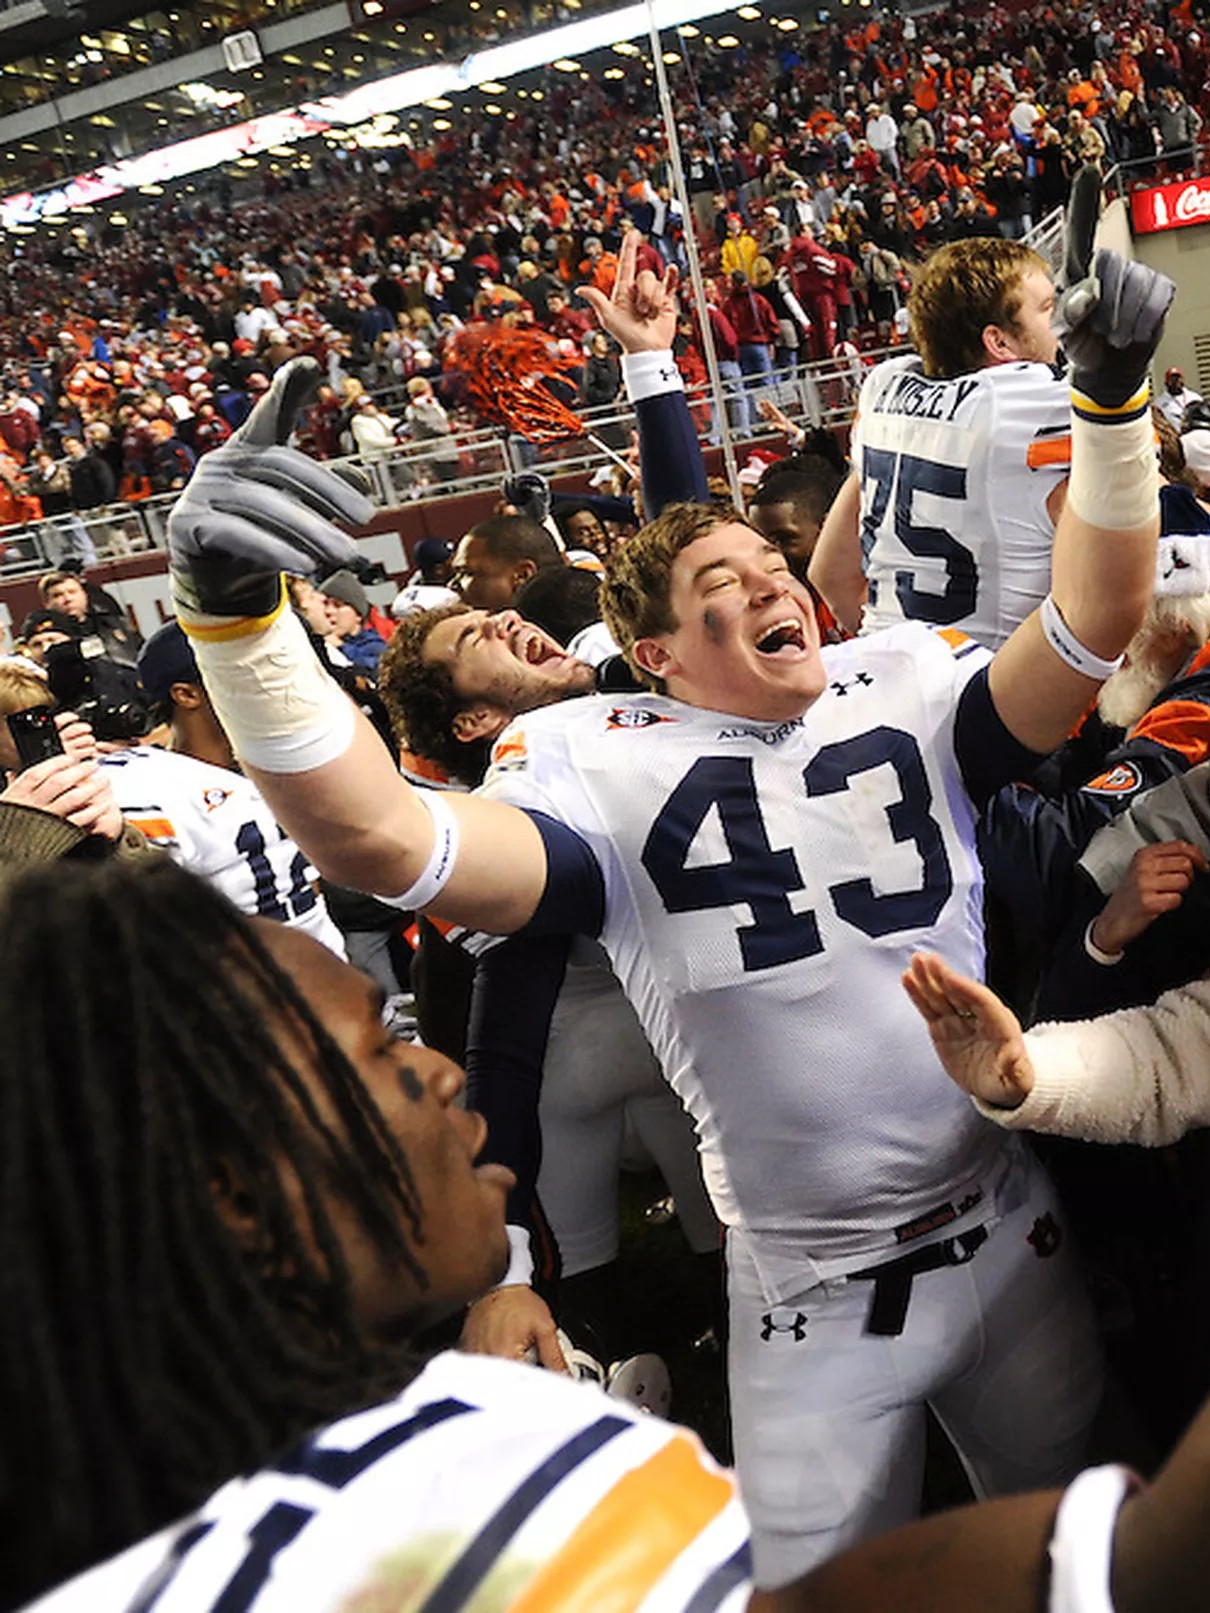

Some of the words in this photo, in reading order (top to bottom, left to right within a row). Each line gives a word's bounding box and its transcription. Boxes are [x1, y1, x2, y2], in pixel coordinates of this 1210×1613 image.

[861, 444, 979, 625] 75
[717, 717, 805, 745] AUURN
[641, 724, 953, 972] 43
